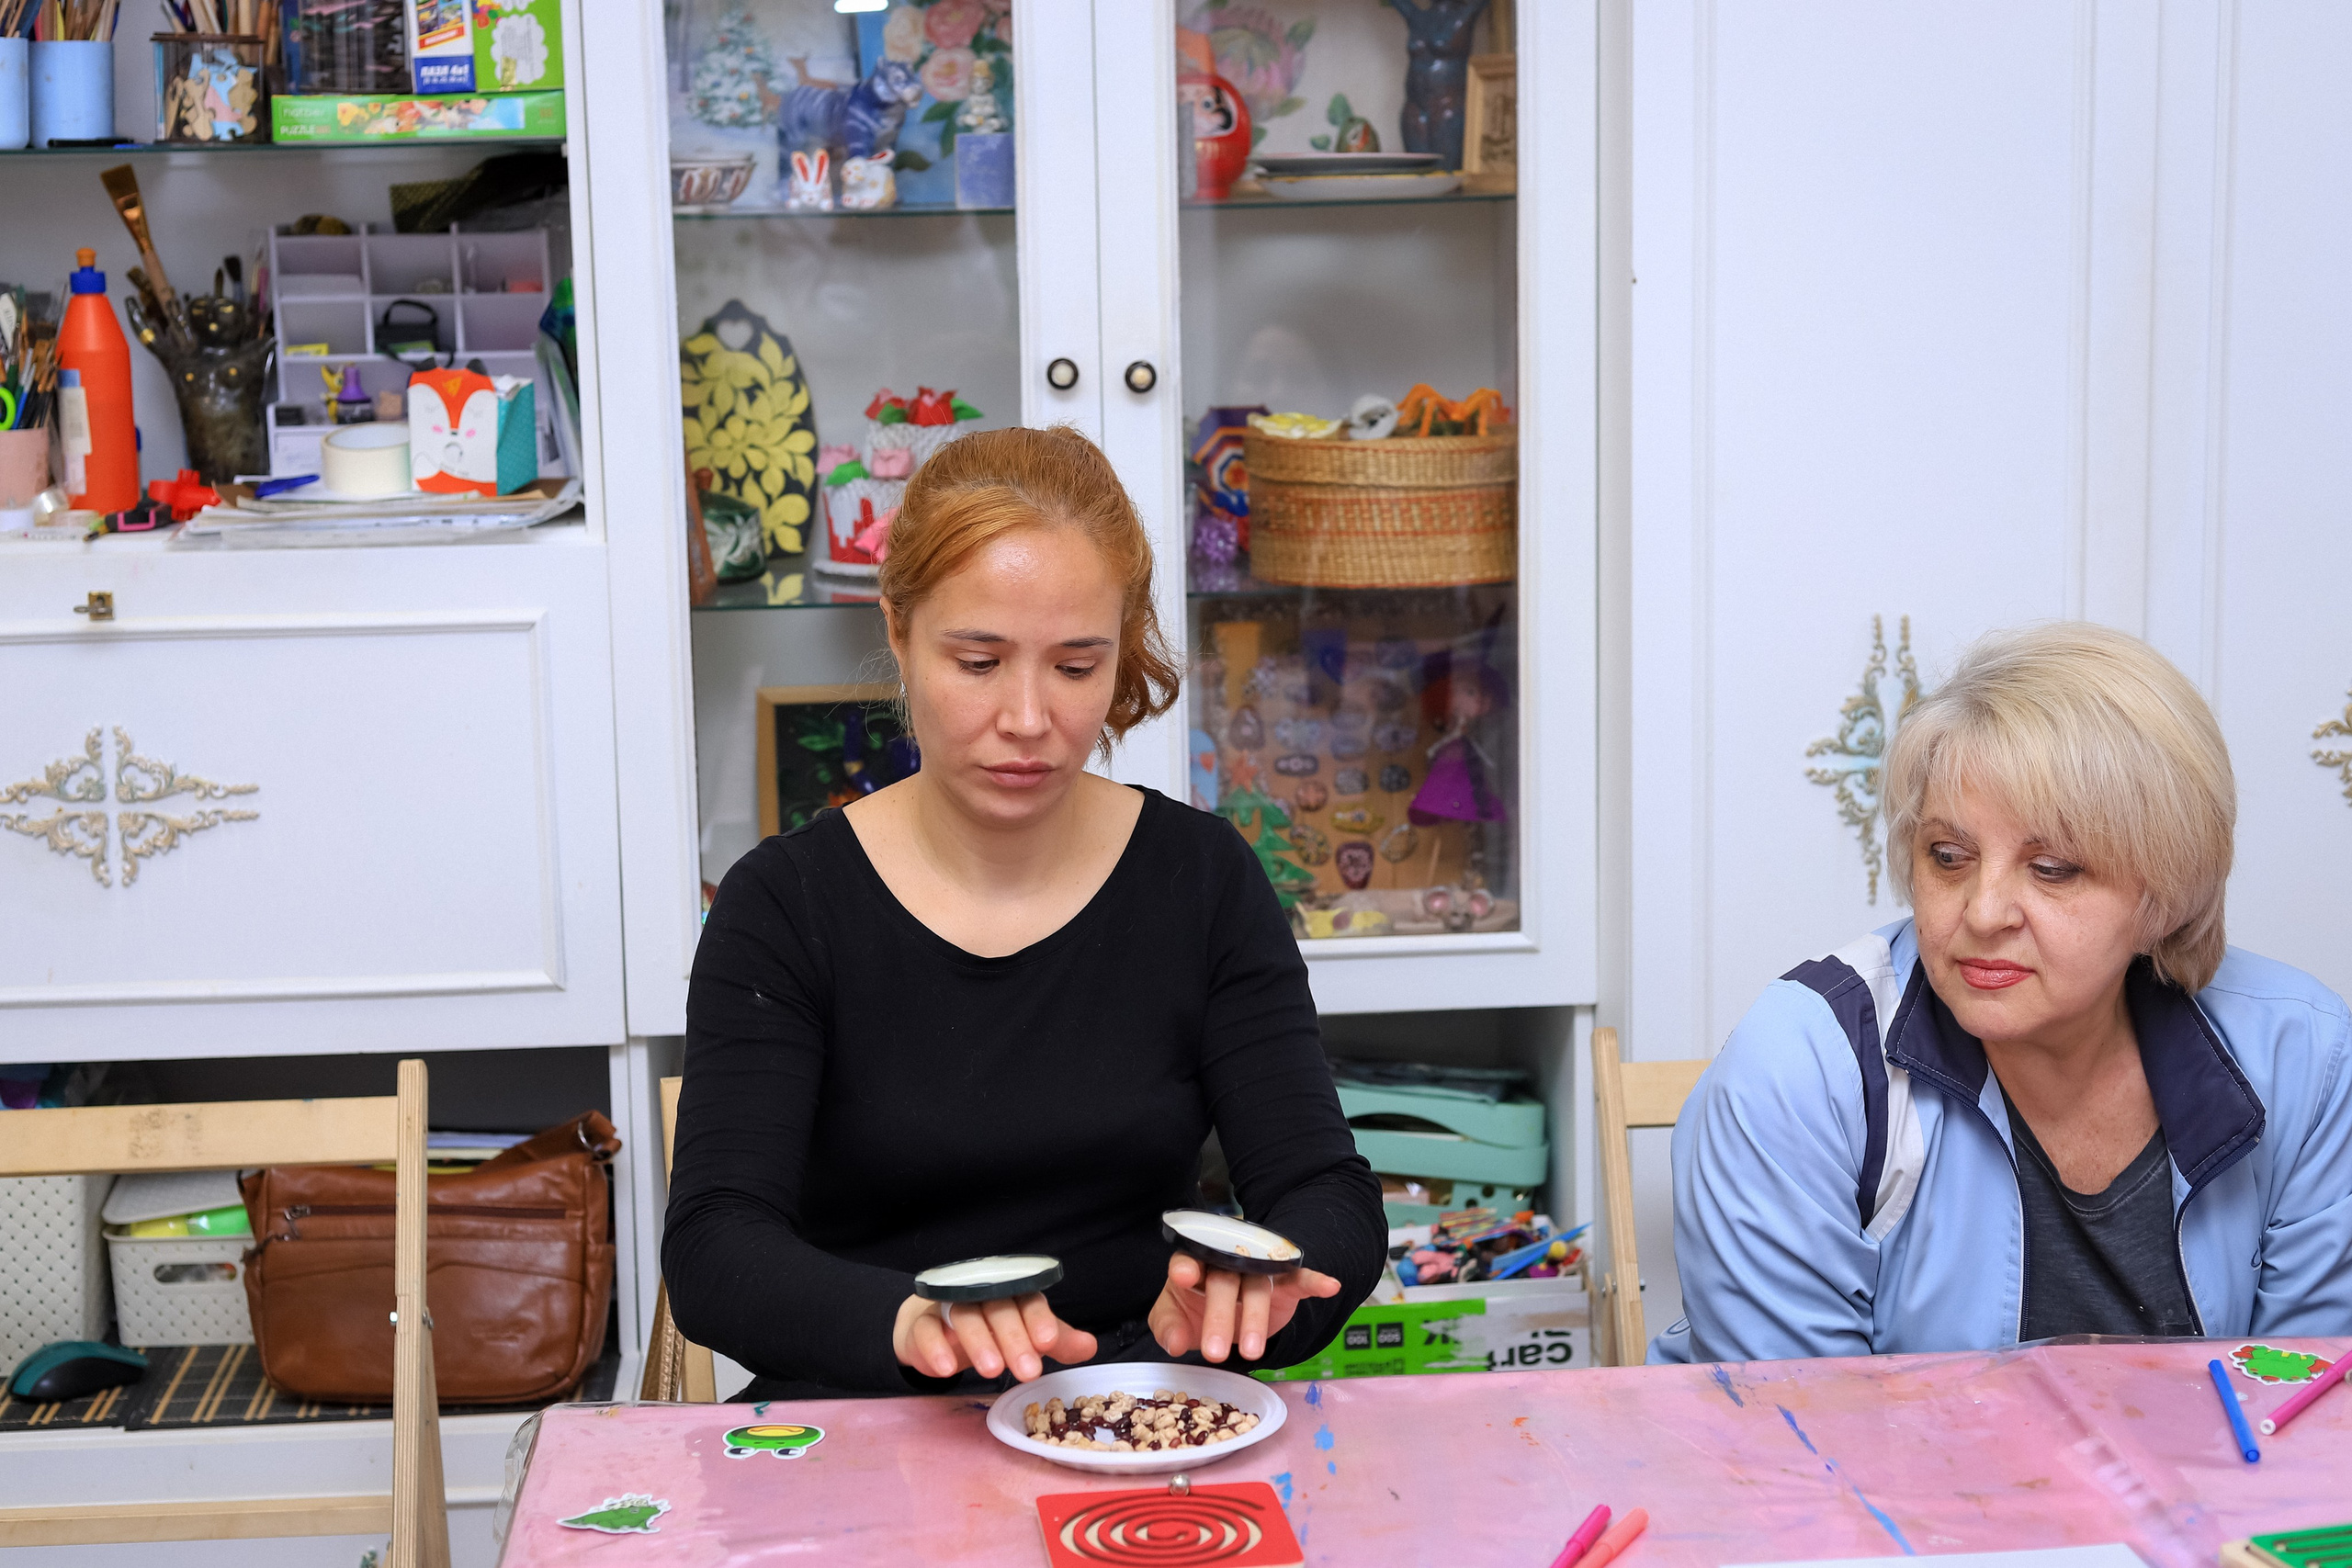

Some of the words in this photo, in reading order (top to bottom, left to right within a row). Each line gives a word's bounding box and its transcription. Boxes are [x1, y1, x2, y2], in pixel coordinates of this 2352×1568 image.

[280, 124, 315, 135] PUZZLE
[1346, 1335, 1368, 1345] 100
[1377, 1333, 1401, 1344] 500
